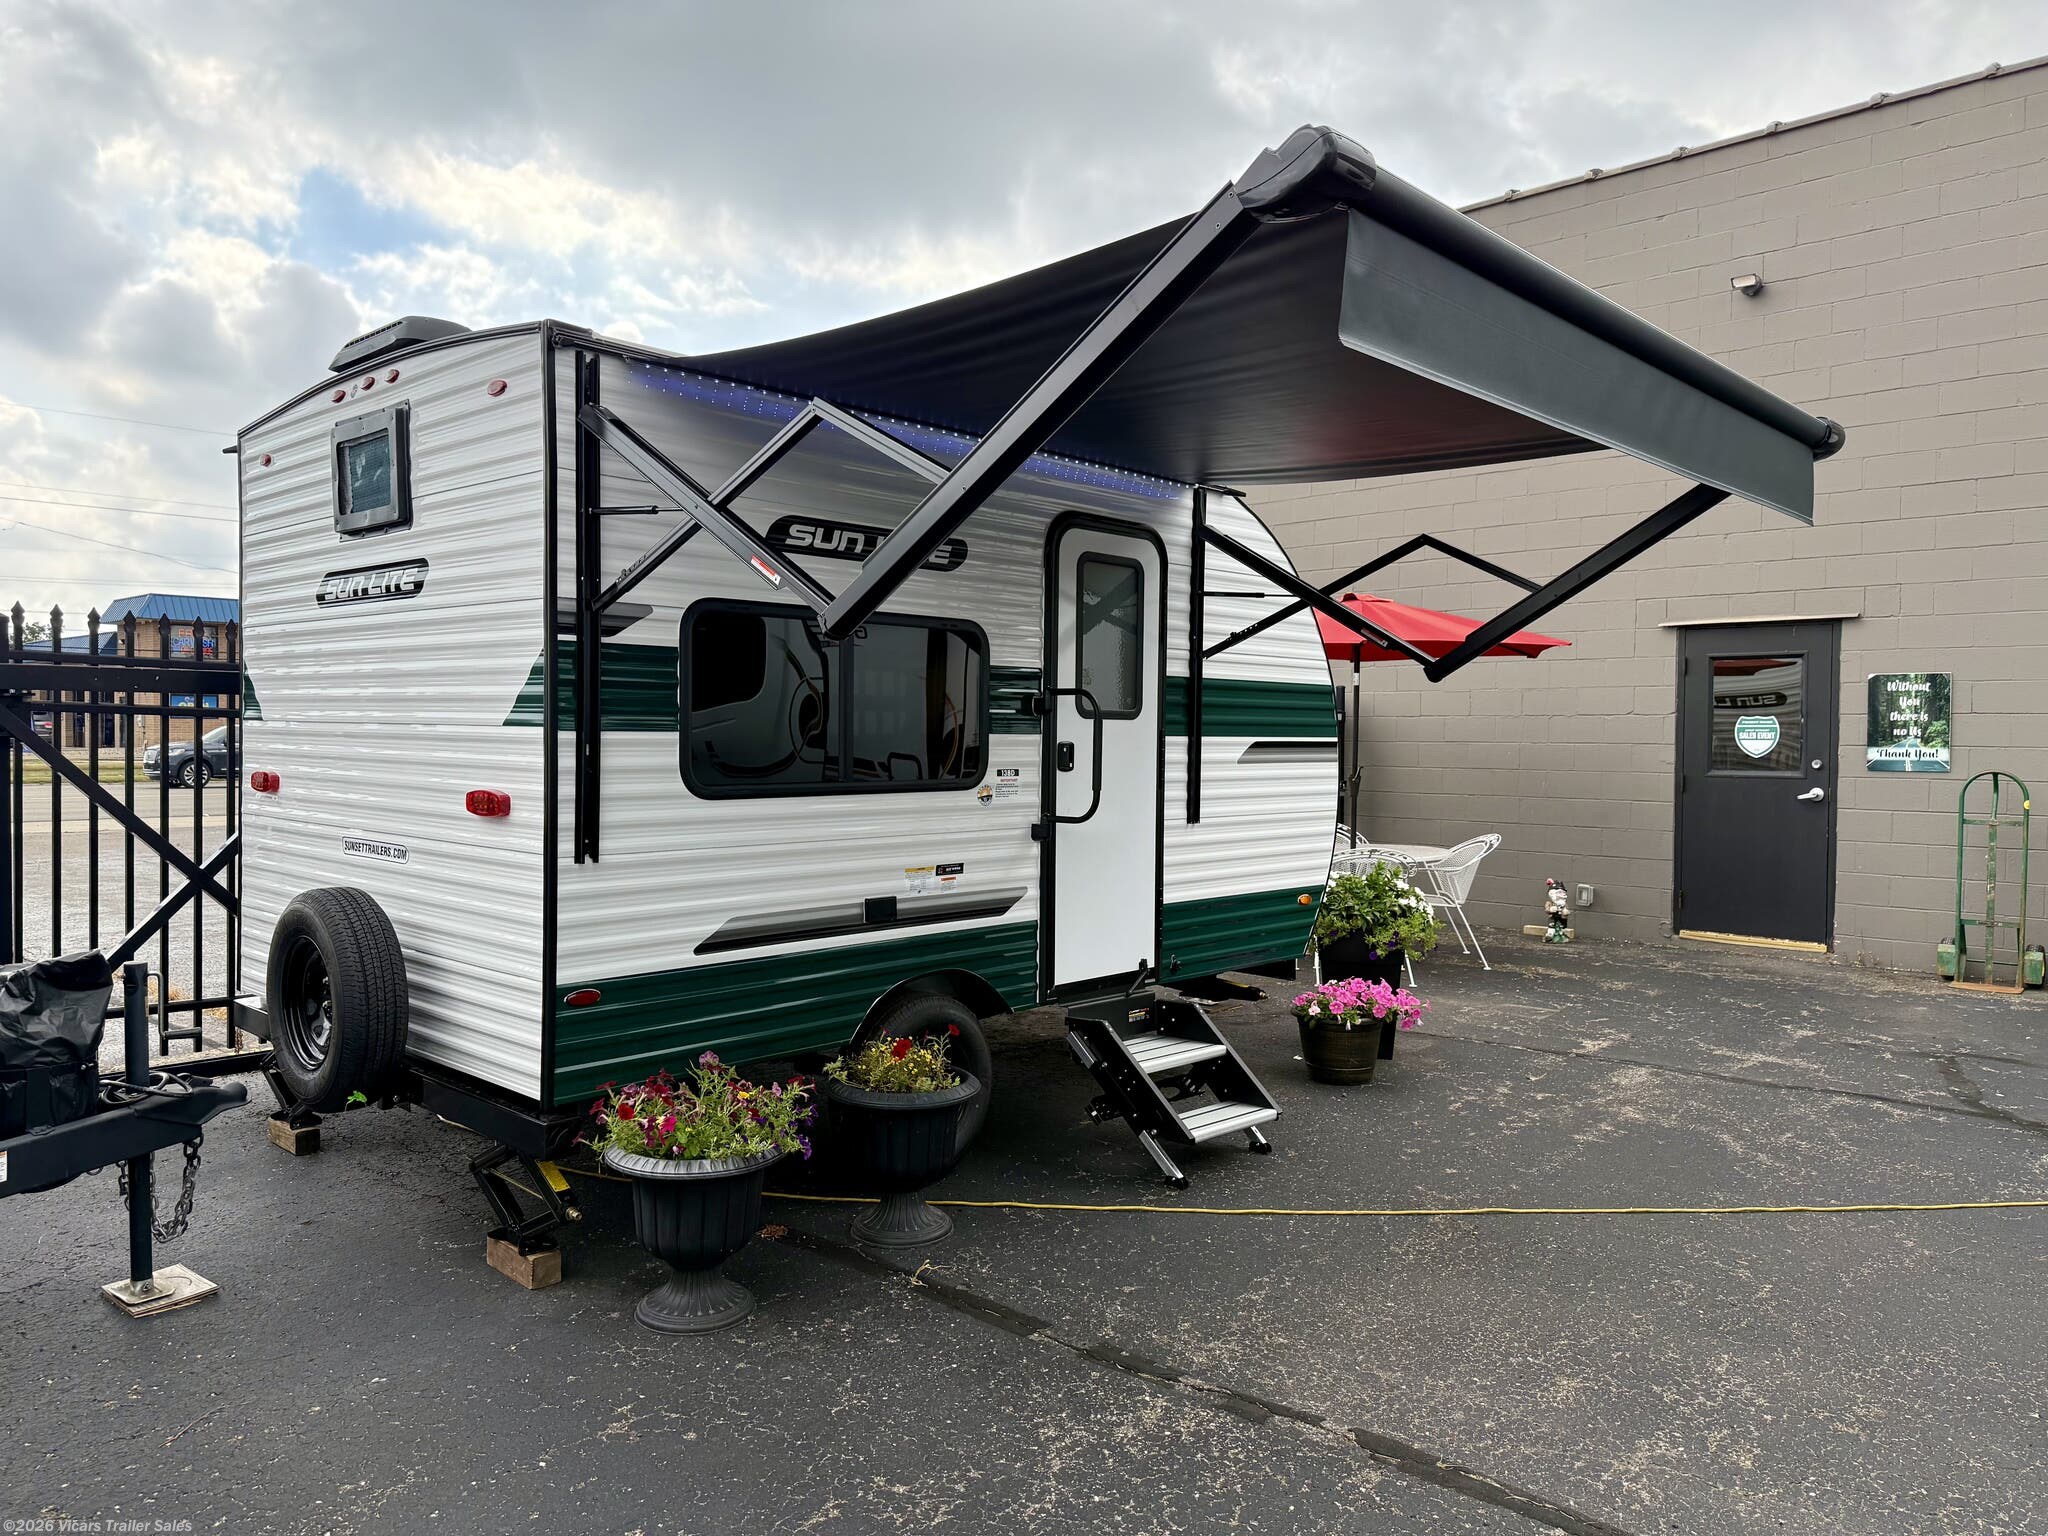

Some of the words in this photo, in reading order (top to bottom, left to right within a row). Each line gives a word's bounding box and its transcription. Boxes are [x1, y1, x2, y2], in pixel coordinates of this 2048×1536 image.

[785, 524, 865, 553] SUN
[325, 576, 366, 600] SUN
[368, 568, 418, 594] LITE
[1887, 680, 1931, 692] Without
[1899, 696, 1921, 709] You
[1890, 711, 1919, 721] there
[1920, 711, 1929, 722] is
[1757, 732, 1776, 740] EVENT
[1893, 728, 1907, 736] no
[1877, 748, 1912, 758] Thank
[1915, 749, 1939, 761] You!
[344, 840, 407, 861] SUNSETTRAILERS.COM
